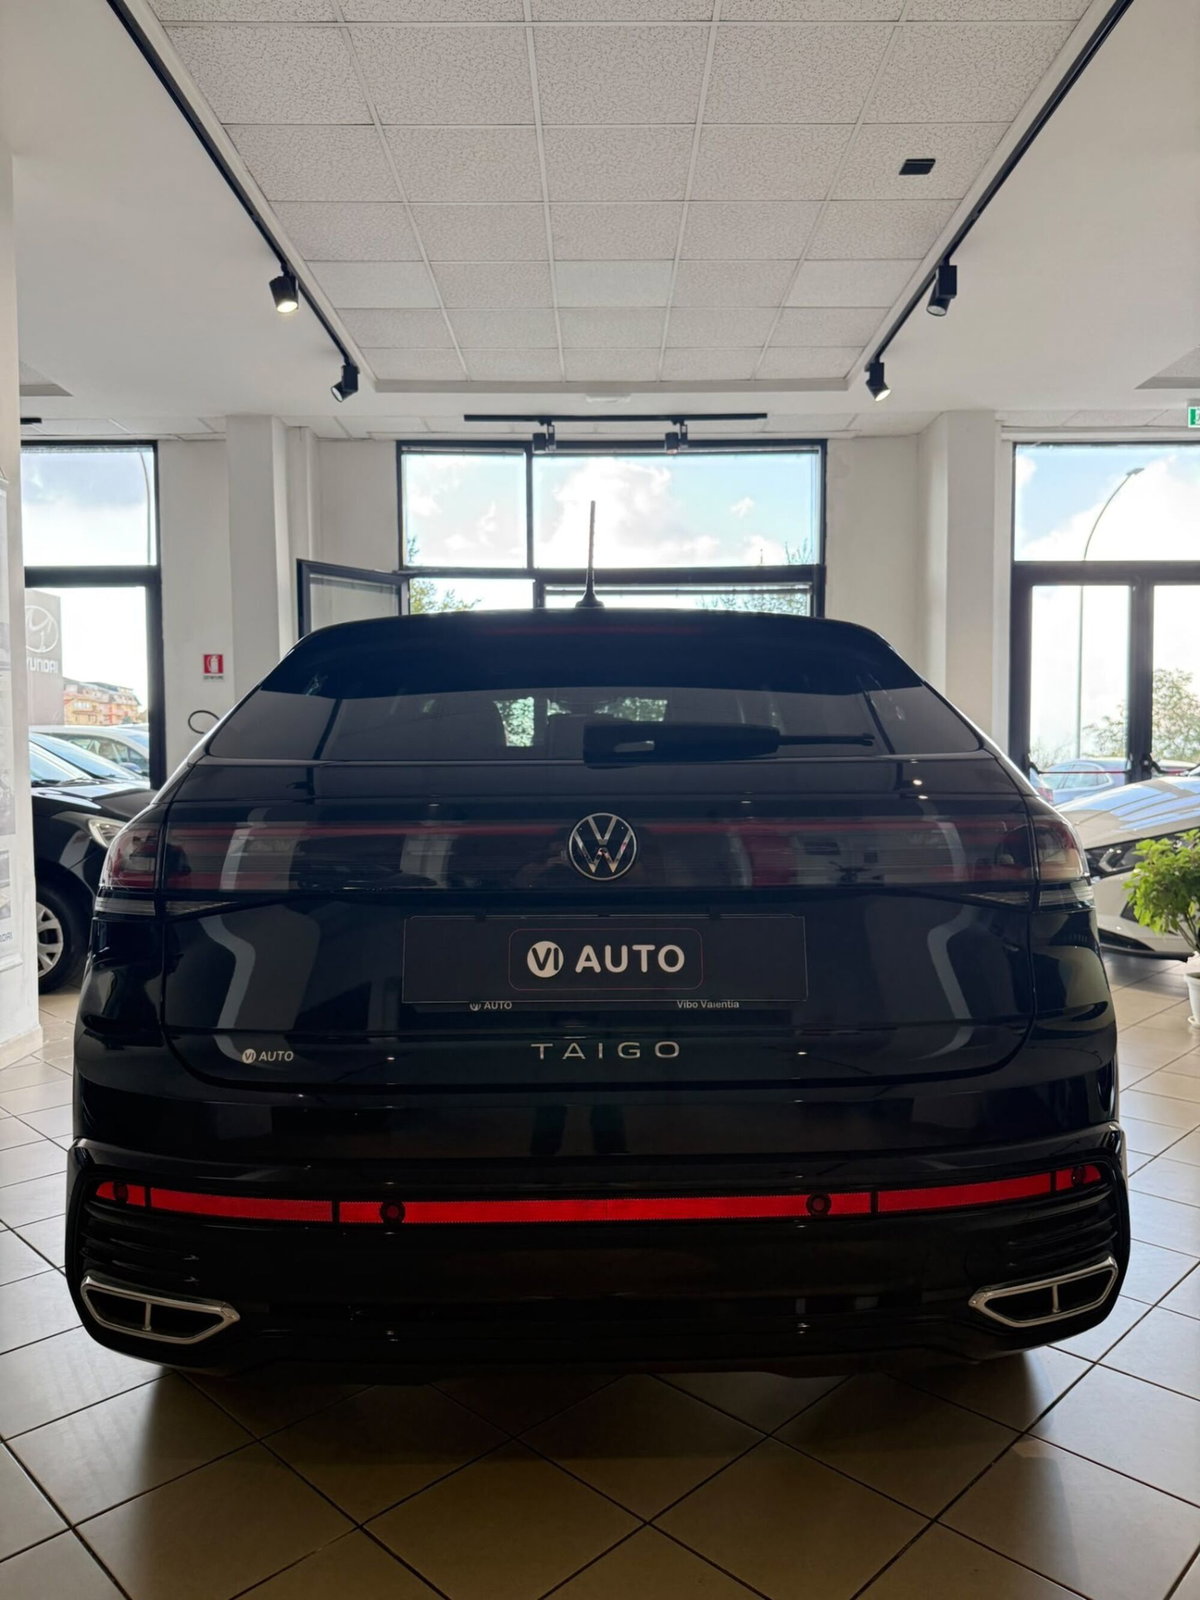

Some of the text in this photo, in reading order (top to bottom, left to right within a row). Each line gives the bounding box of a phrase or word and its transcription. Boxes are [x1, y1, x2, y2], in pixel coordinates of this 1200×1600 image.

[575, 944, 685, 973] AUTO
[484, 1000, 513, 1010] AUTO
[676, 999, 698, 1009] Vibo
[258, 1050, 294, 1062] AUTO
[530, 1041, 681, 1060] TAIGO
